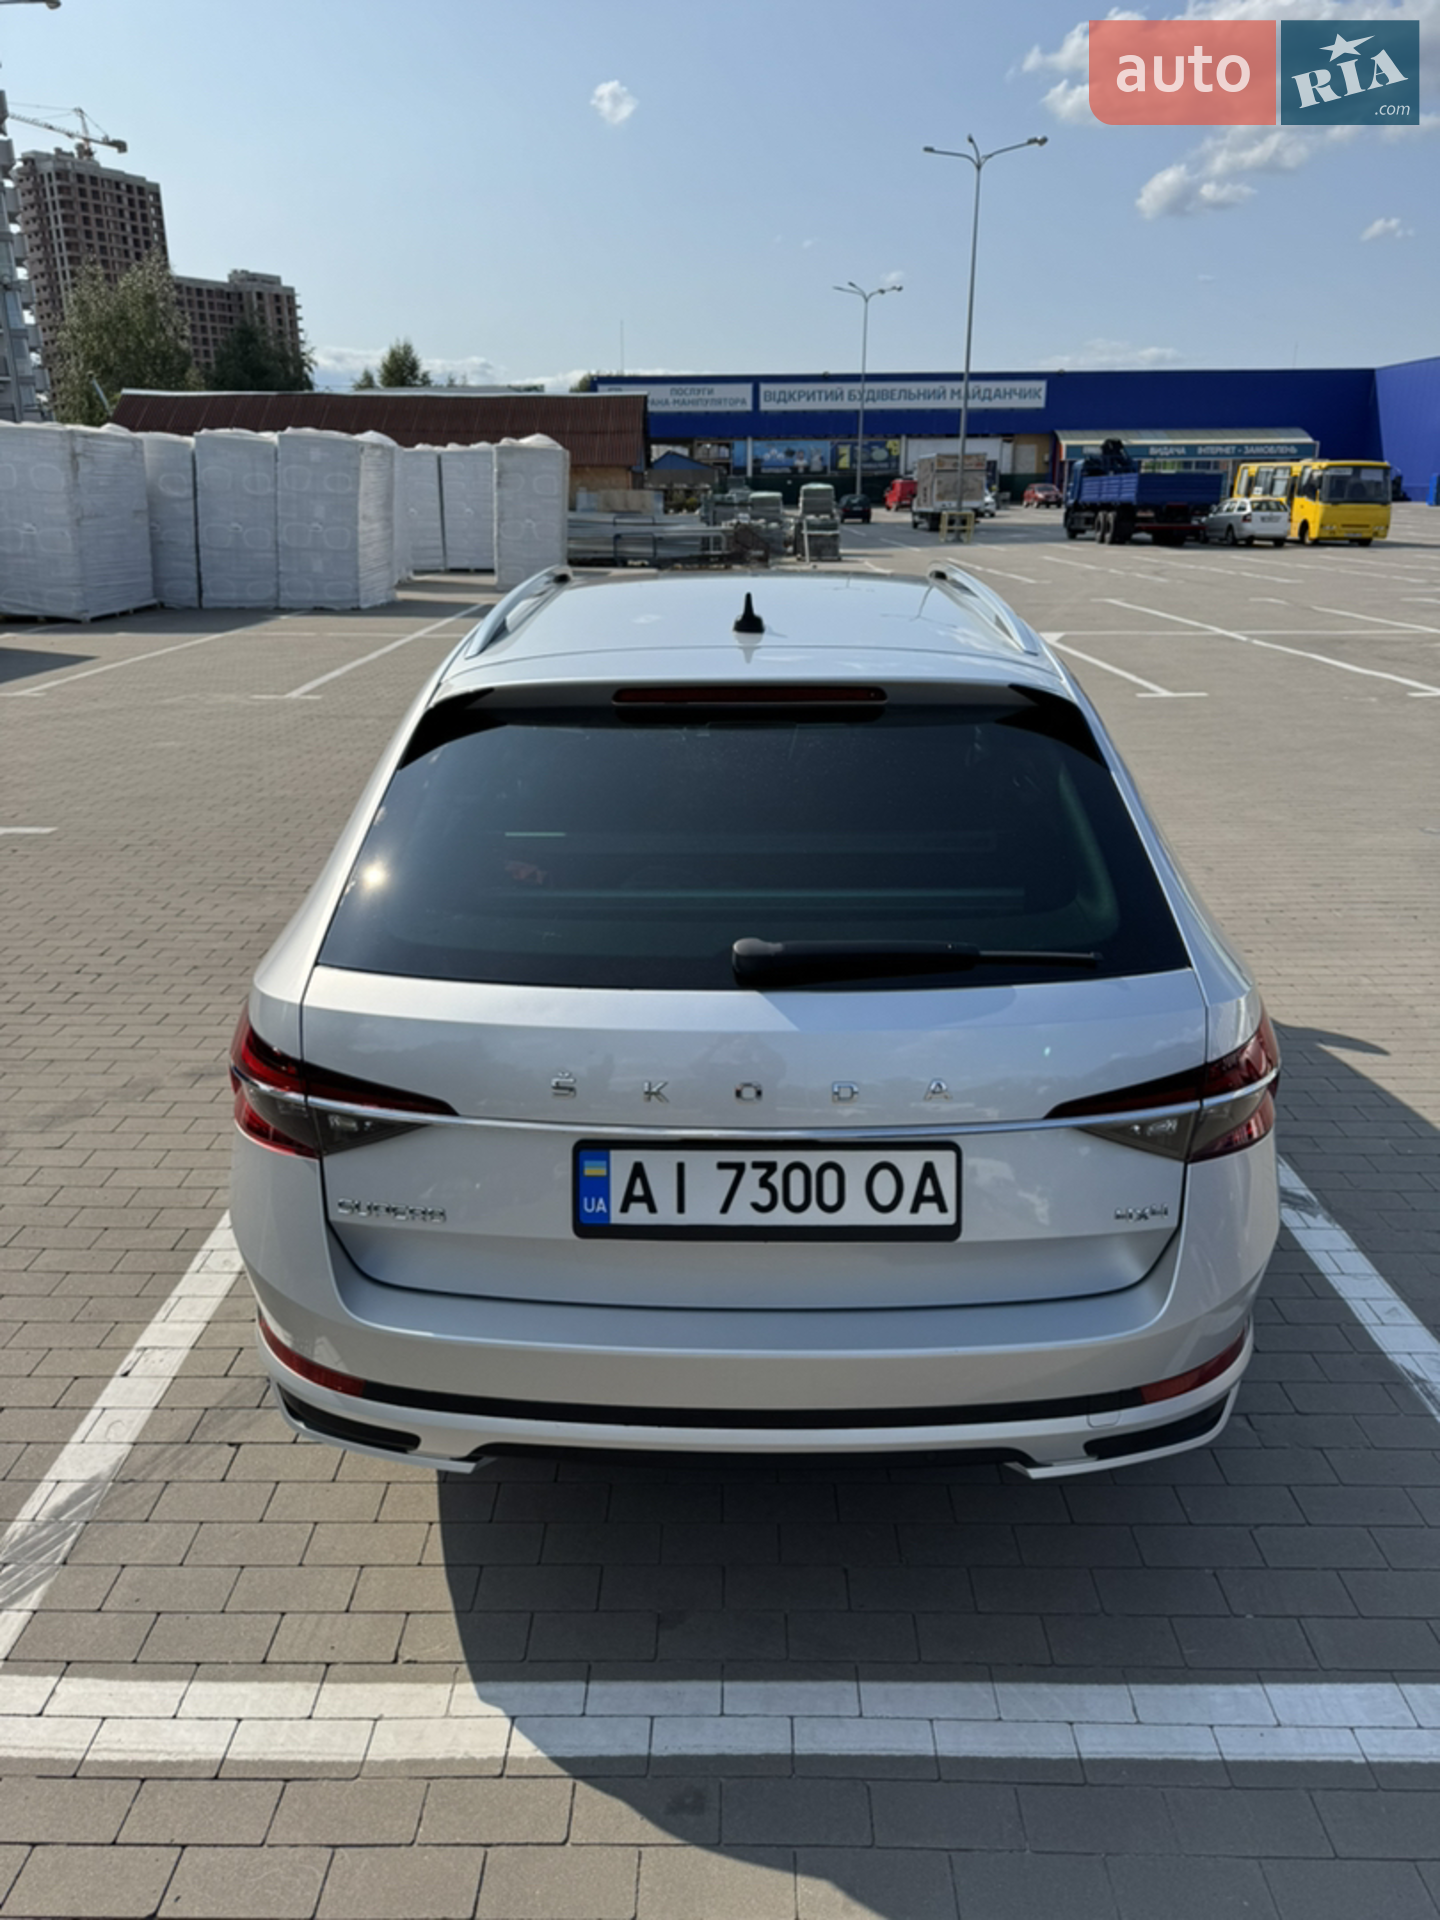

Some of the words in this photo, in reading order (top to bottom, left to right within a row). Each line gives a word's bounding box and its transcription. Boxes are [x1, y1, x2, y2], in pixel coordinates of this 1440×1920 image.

[669, 387, 715, 397] ПОСЛУГИ
[763, 387, 844, 404] ВІДКРИТИЙ
[847, 386, 946, 403] БУДІВЕЛЬНИЙ
[1149, 445, 1186, 456] ВИДАЧА
[1197, 445, 1236, 455] ІНТЕРНЕТ
[1244, 444, 1298, 455] ЗАМОВЛЕНЬ
[716, 1161, 846, 1213] 7300
[338, 1198, 447, 1222] SUPERB
[584, 1197, 608, 1214] UA
